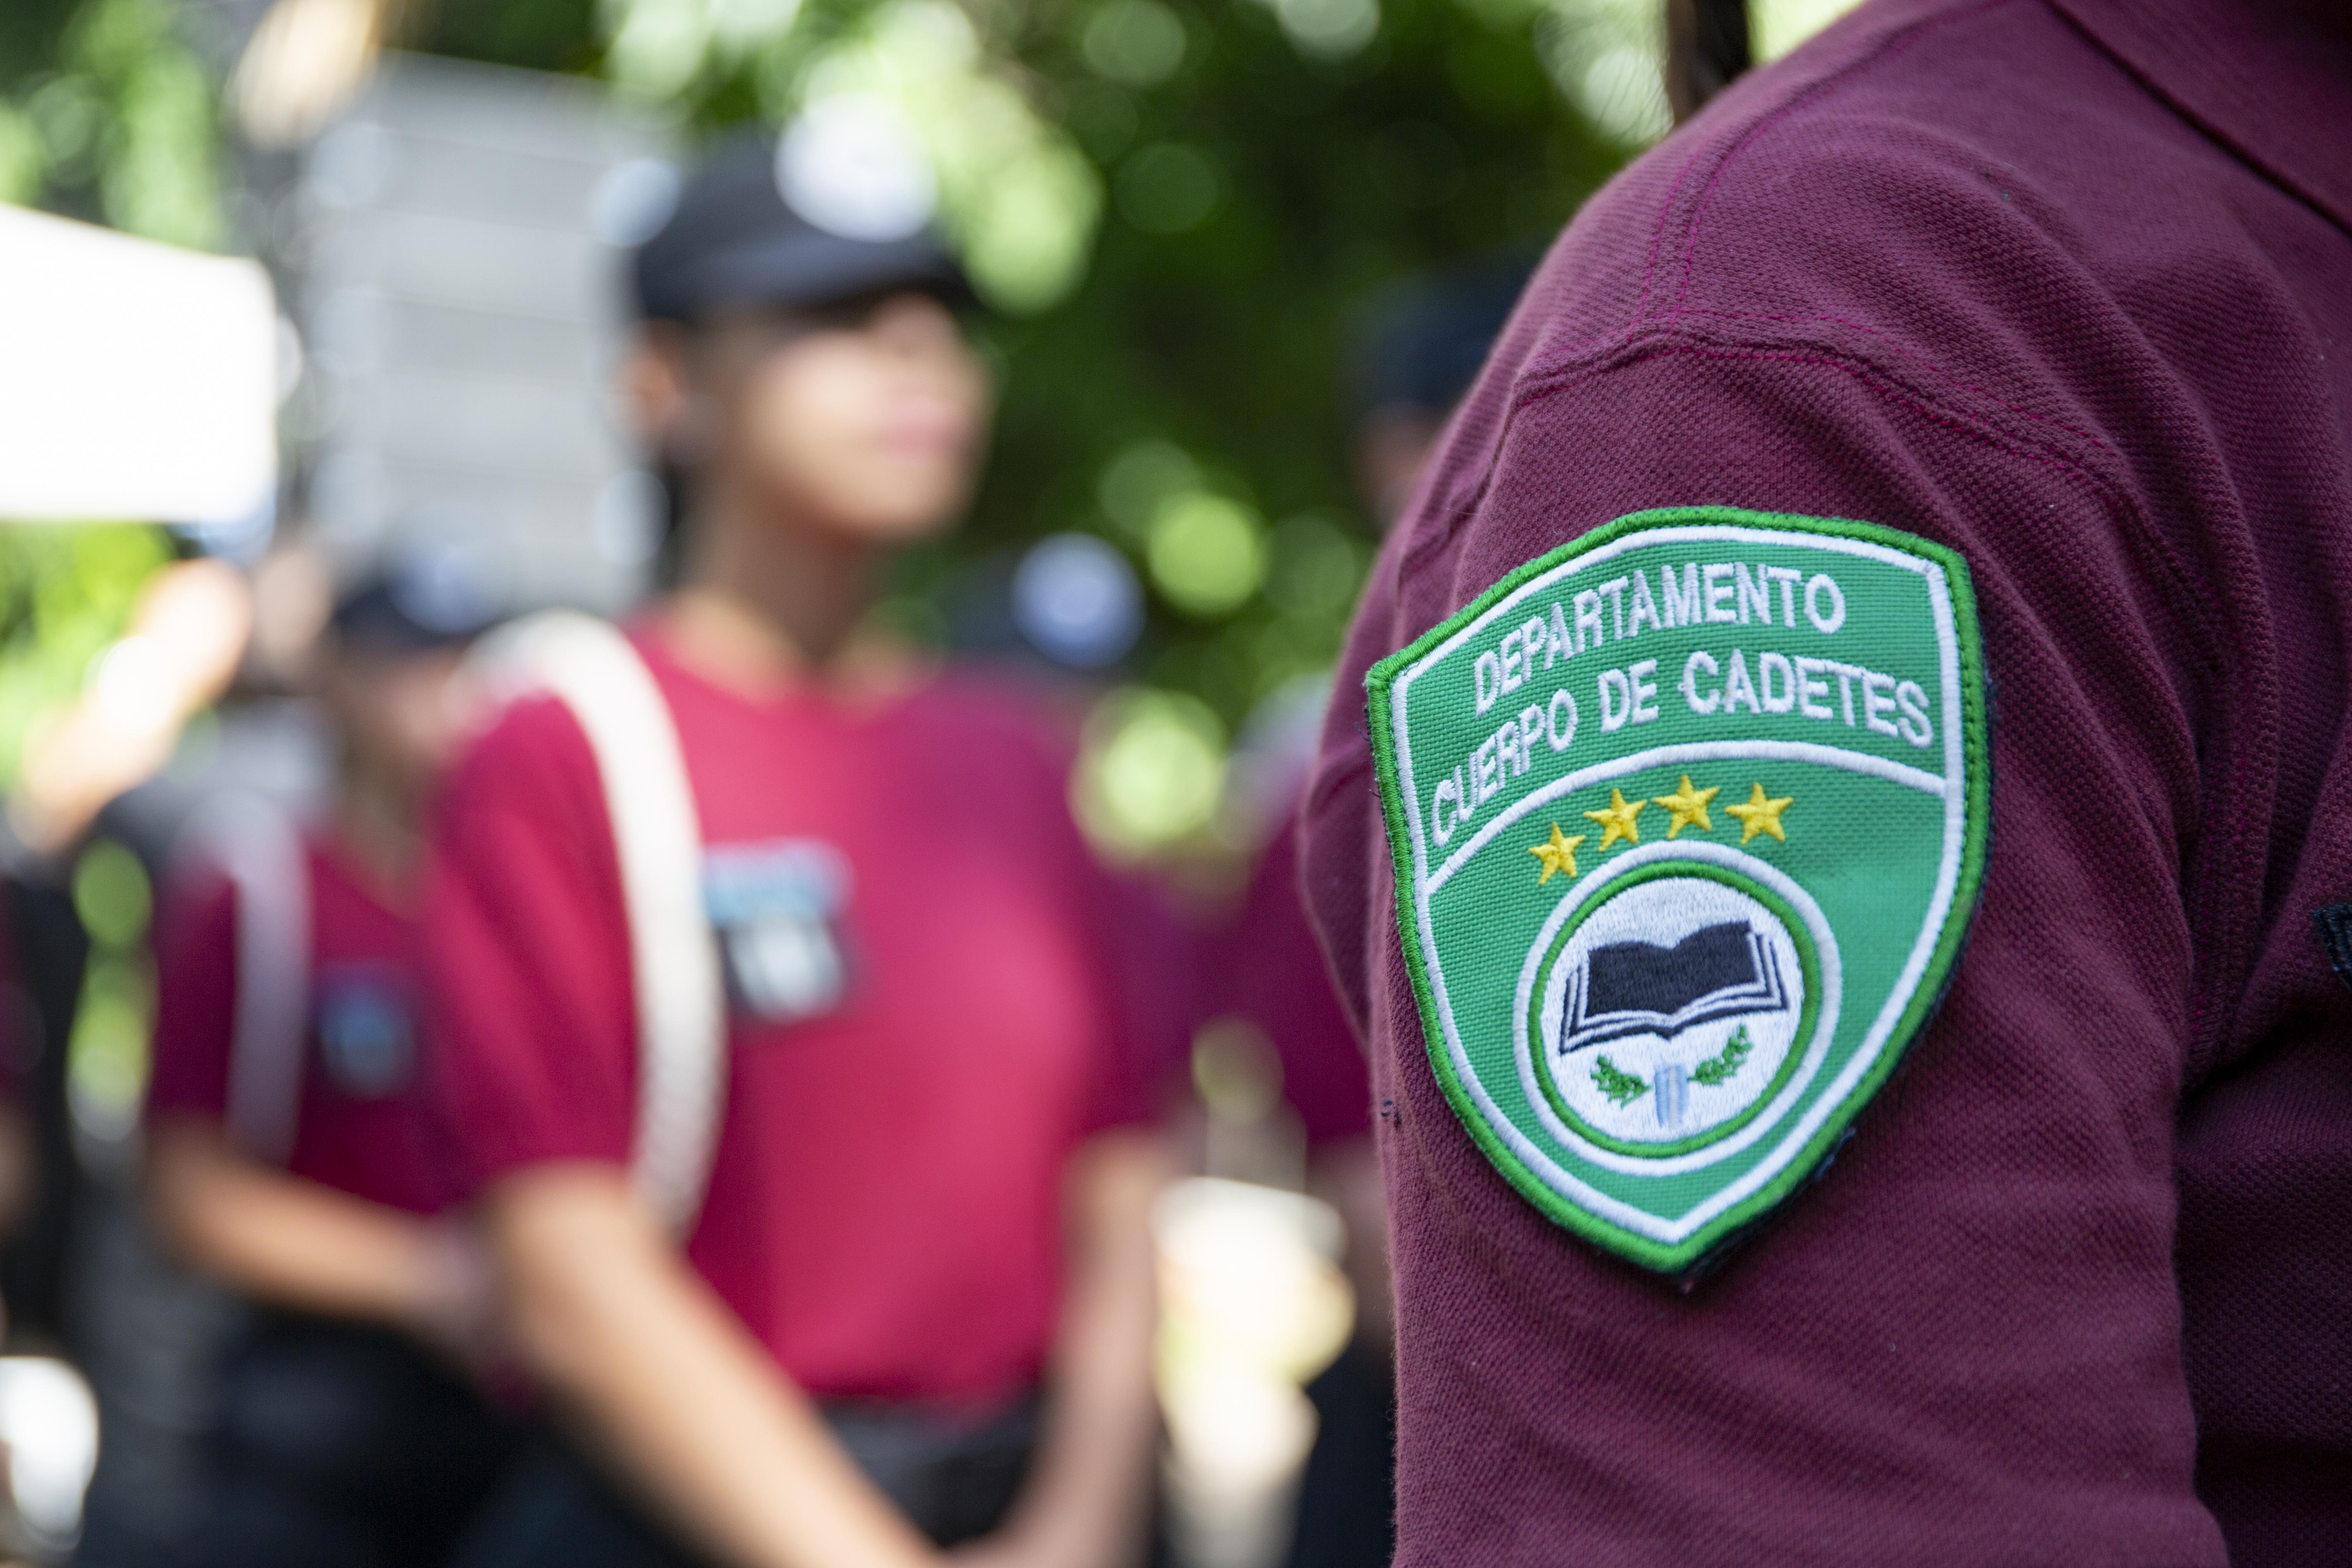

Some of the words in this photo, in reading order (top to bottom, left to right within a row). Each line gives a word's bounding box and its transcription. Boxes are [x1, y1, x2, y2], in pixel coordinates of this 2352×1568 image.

[1474, 562, 1846, 718] DEPARTAMENTO
[1431, 688, 1576, 847] CUERPO
[1598, 659, 1659, 733] DE
[1679, 649, 1934, 746] CADETES
